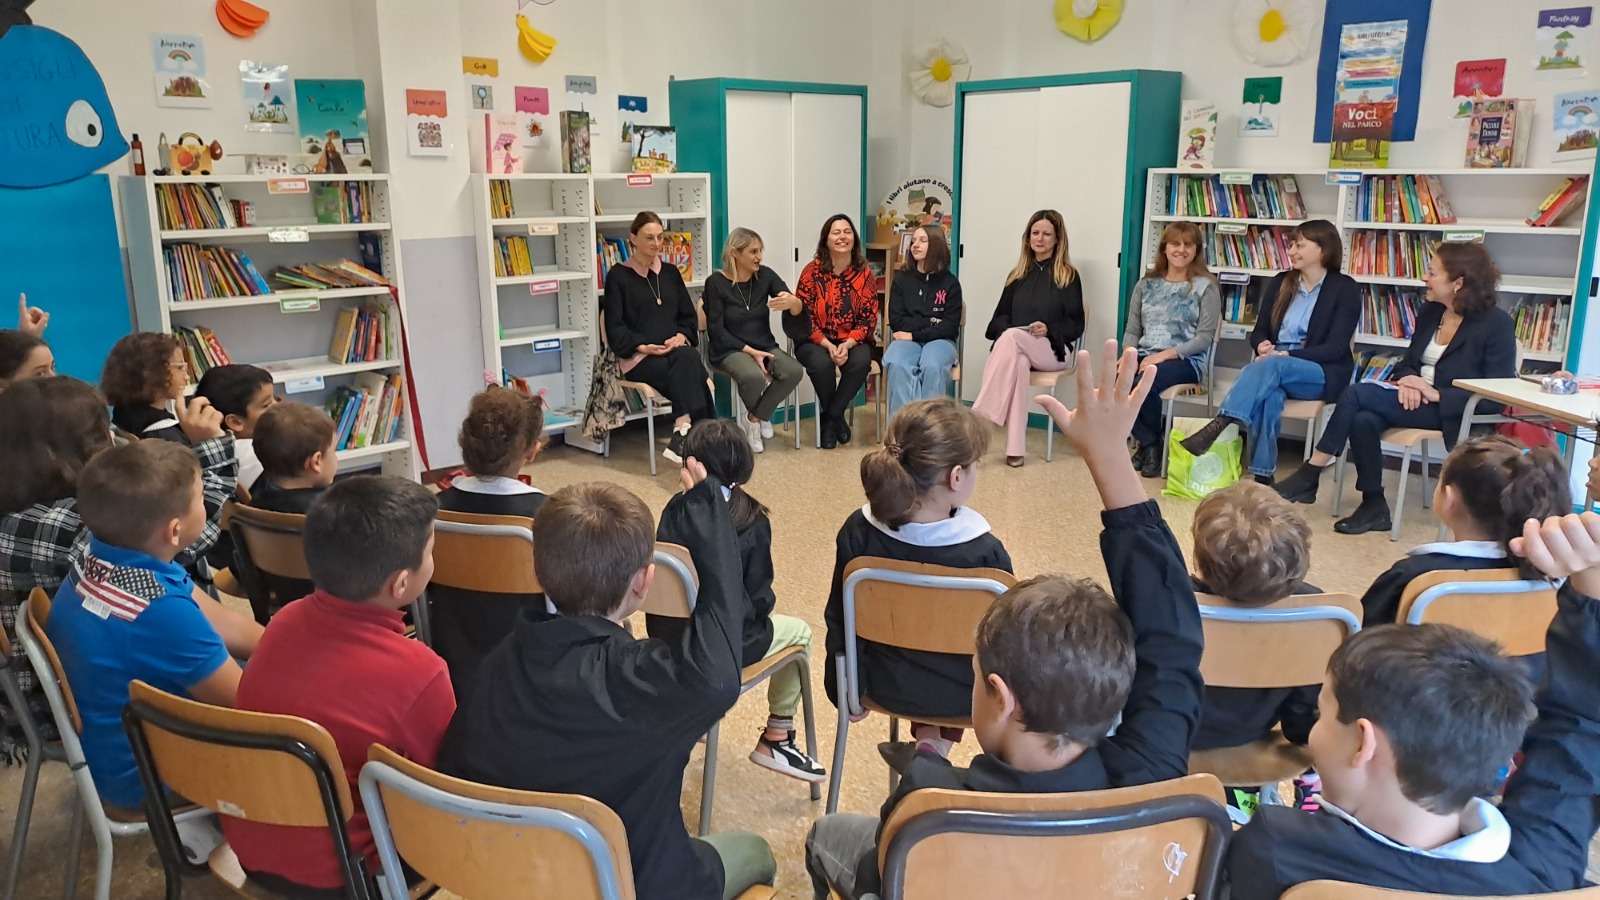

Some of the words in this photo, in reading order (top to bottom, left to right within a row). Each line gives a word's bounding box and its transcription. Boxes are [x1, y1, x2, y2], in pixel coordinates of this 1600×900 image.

[1548, 14, 1580, 24] Fantasy
[1348, 107, 1378, 121] Voci
[1342, 121, 1357, 129] NEL
[1358, 120, 1383, 128] PARCO
[889, 186, 903, 202] libri
[903, 178, 931, 190] aiutano
[659, 240, 689, 255] ERCA
